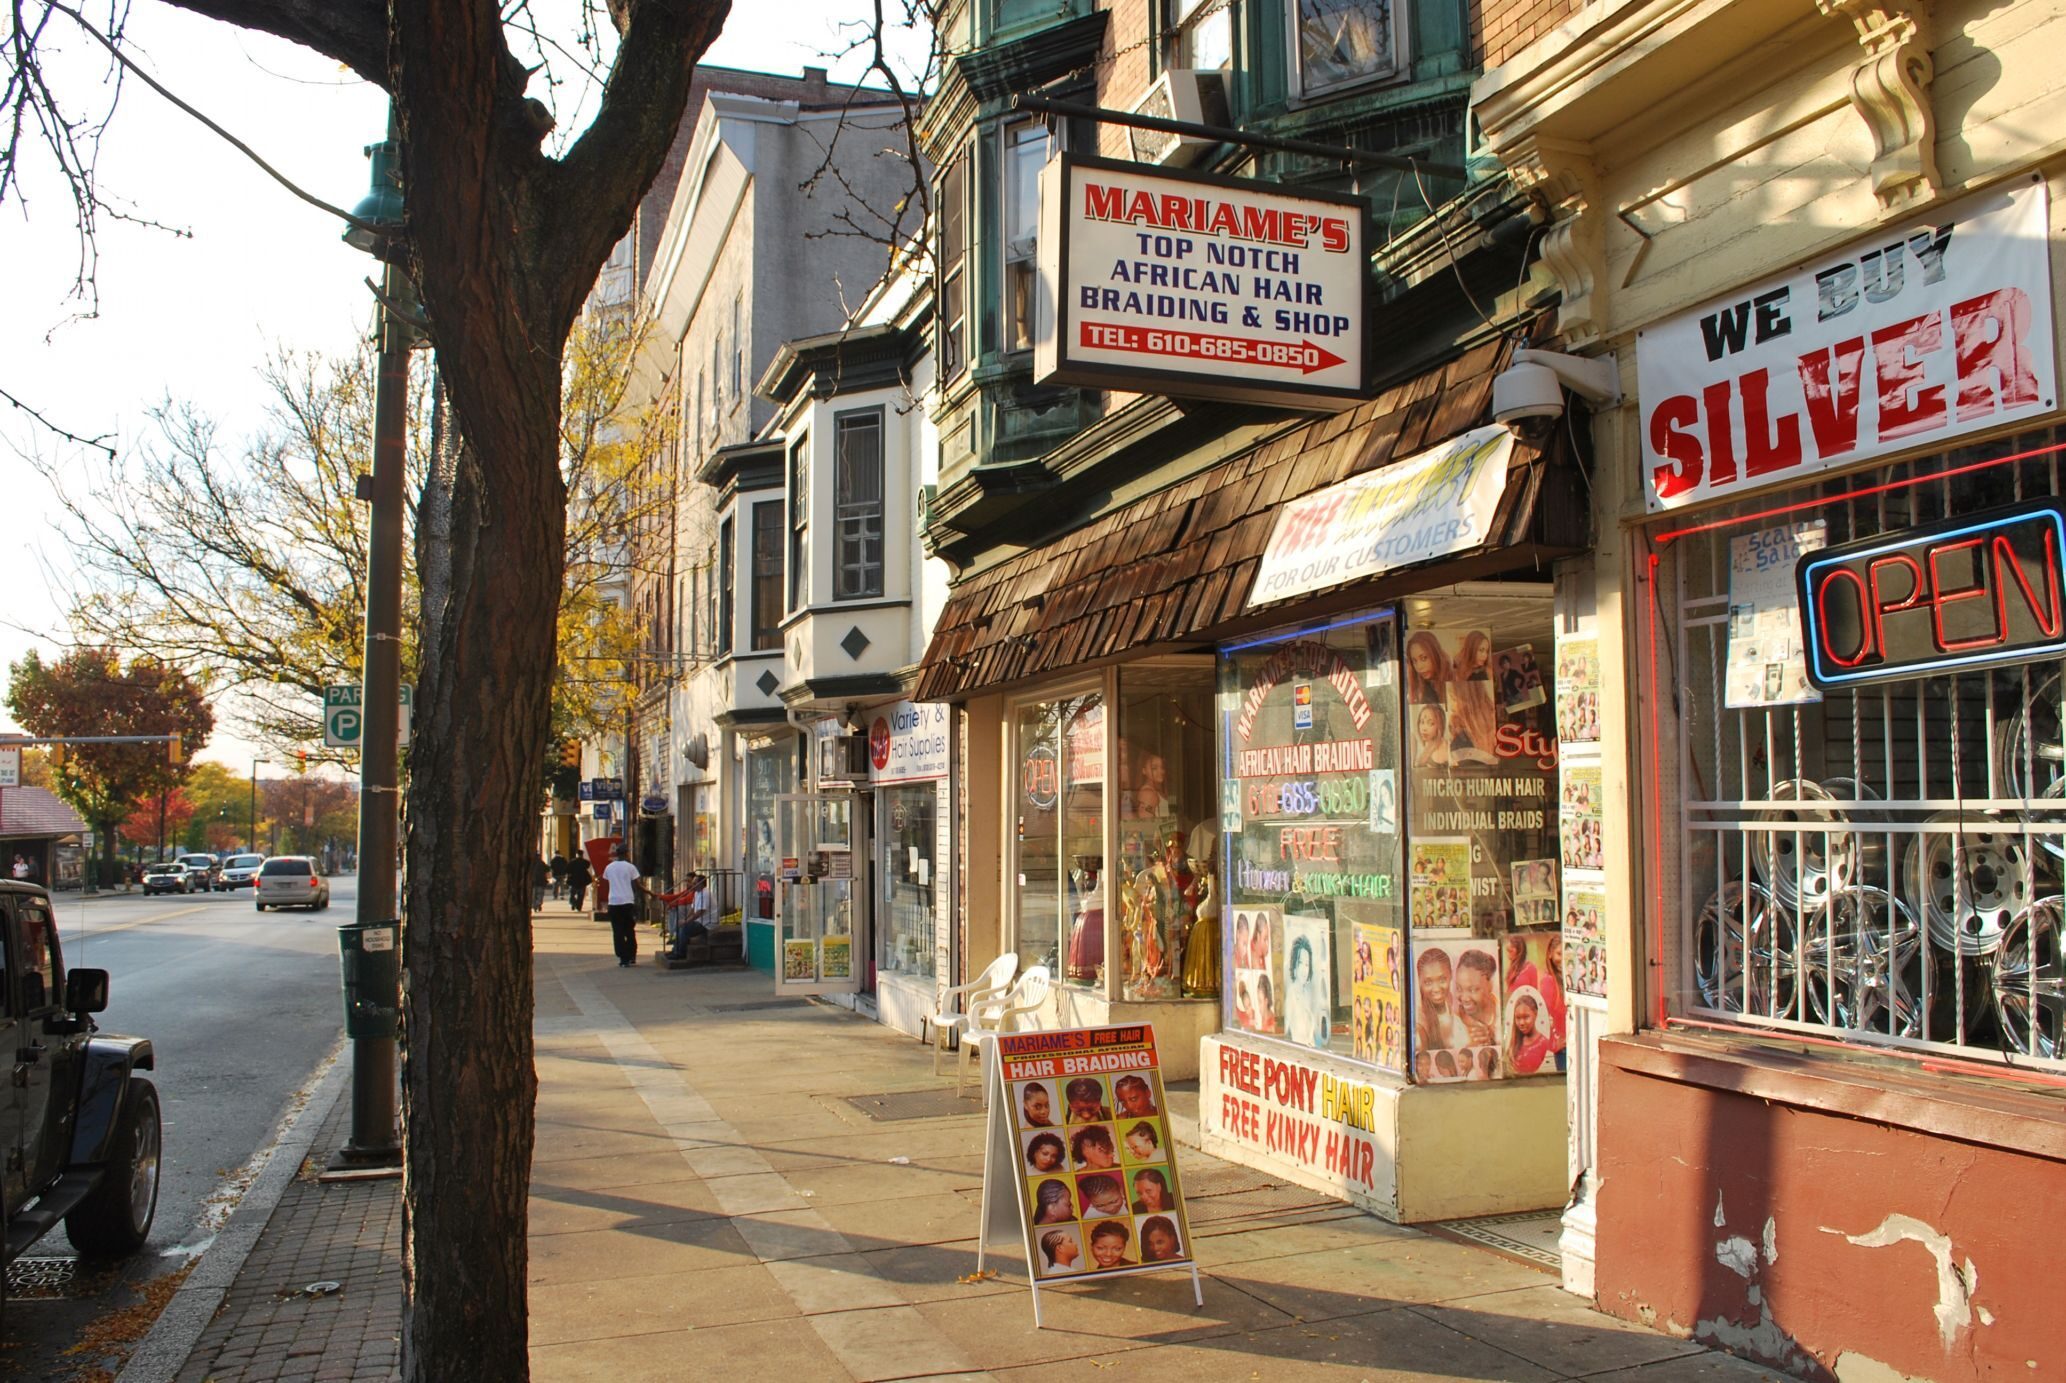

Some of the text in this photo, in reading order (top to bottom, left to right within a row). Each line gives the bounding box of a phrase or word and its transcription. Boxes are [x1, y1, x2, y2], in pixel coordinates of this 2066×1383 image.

[1084, 183, 1350, 253] MARIAME'S
[1136, 233, 1300, 275] TOP NOTCH
[1110, 259, 1322, 306] AFRICAN HAIR
[1700, 222, 1954, 362] WE BUY
[1080, 285, 1350, 337] BRAIDING & SHOP
[1088, 325, 1319, 367] TEL: 610-685-0850
[1650, 286, 2040, 498] SILVER
[1263, 514, 1475, 592] FOR OUR CUSTOMERS
[1819, 527, 2060, 667] OPEN
[1237, 640, 1298, 742] MARIAME'S
[1327, 656, 1374, 733] NOTCH
[890, 702, 945, 733] Variety &
[1297, 710, 1311, 721] VISA
[892, 738, 909, 760] Hair
[909, 732, 946, 760] Supplies
[1239, 739, 1374, 778] AFRICAN HAIR BRAIDING
[1024, 758, 1059, 795] OPEN
[1422, 778, 1546, 798] MICRO HUMAN HAIR
[1424, 811, 1495, 830] INDIVIDUAL
[1498, 811, 1544, 830] BRAIDS
[1280, 826, 1345, 863] FREE
[1349, 873, 1393, 899] HAIR
[1003, 1029, 1141, 1054] MARIAME'S FREE HAIR
[1010, 1051, 1151, 1079] HAIR BRAIDING
[1219, 1043, 1376, 1134] FREE PONY HAIR
[1222, 1093, 1375, 1191] FREE KINKY HAIR
